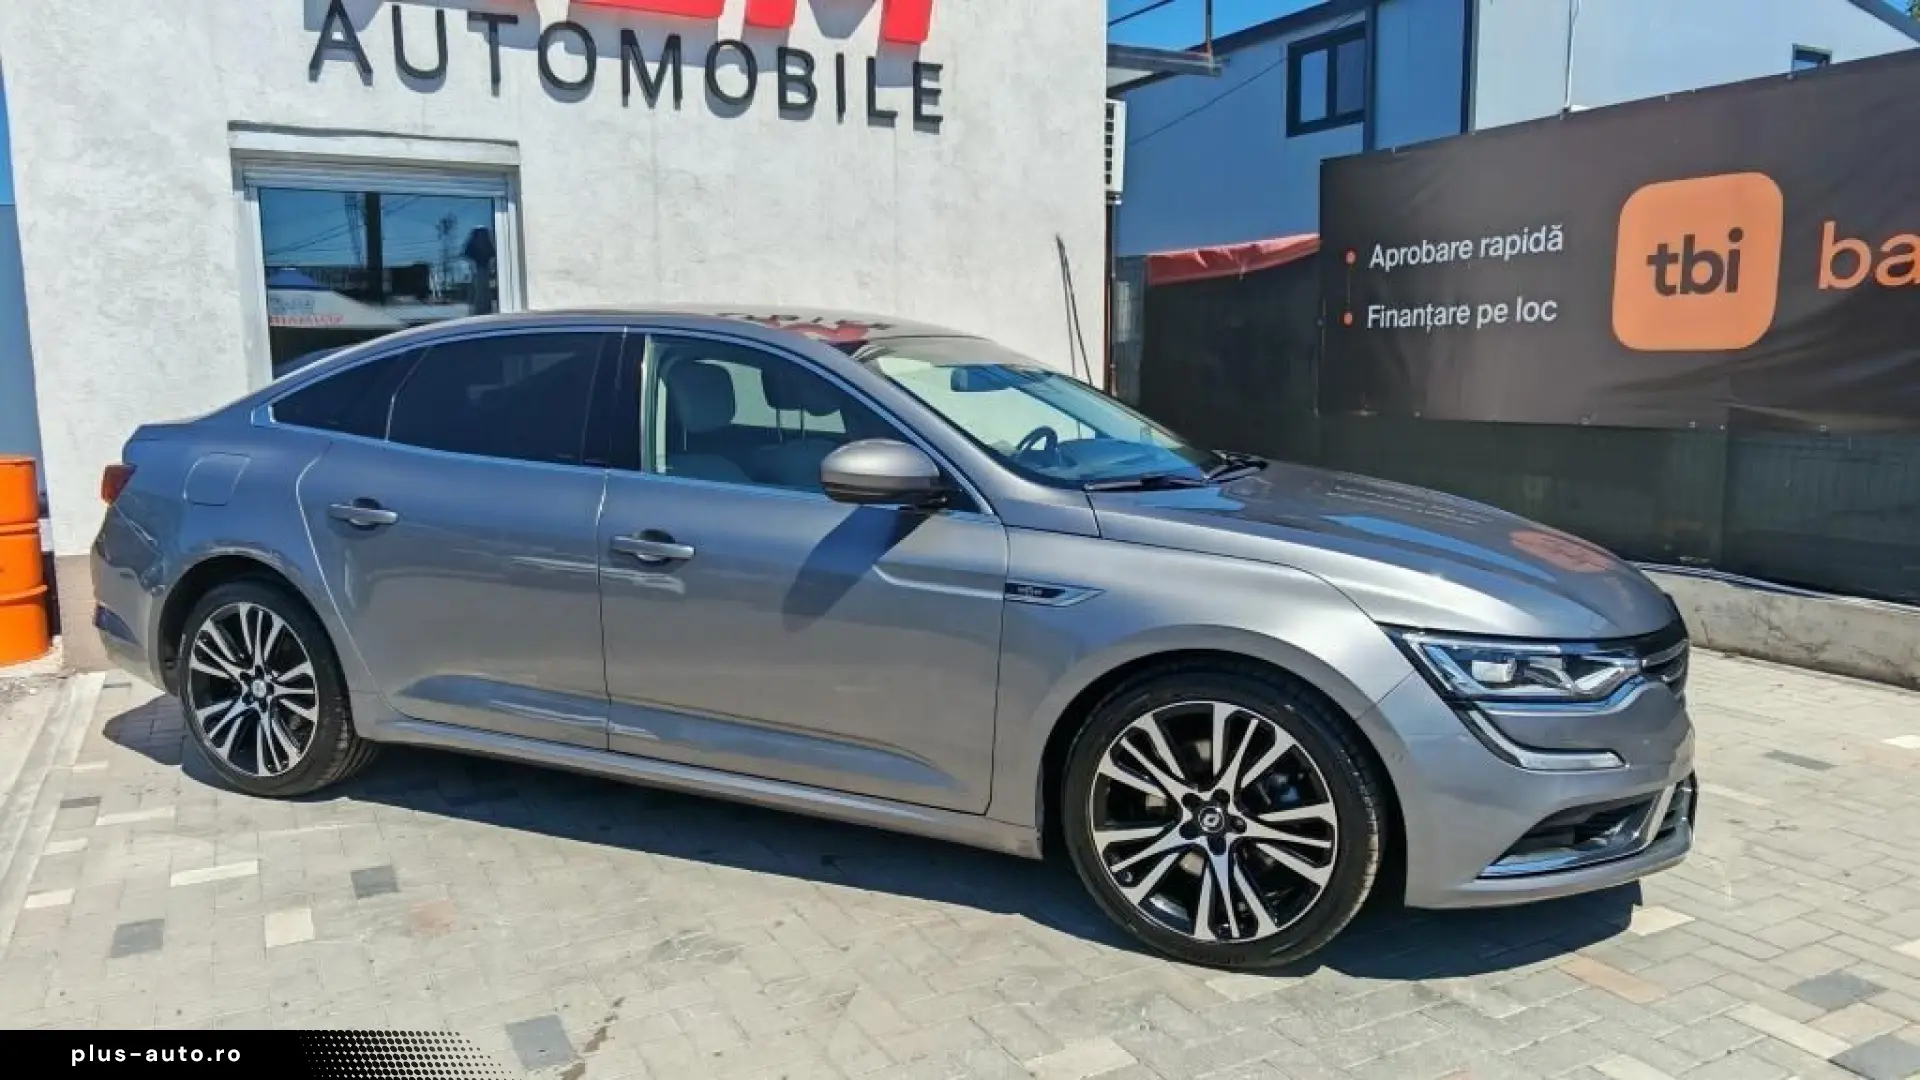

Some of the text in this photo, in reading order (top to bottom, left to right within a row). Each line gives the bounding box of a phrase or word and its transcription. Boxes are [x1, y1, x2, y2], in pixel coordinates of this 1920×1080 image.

[308, 0, 944, 128] AUTOMOBILE
[1369, 223, 1563, 272] Aprobare rapidă
[1646, 220, 1920, 296] tbi ba
[1367, 296, 1558, 334] Finanțare pe loc
